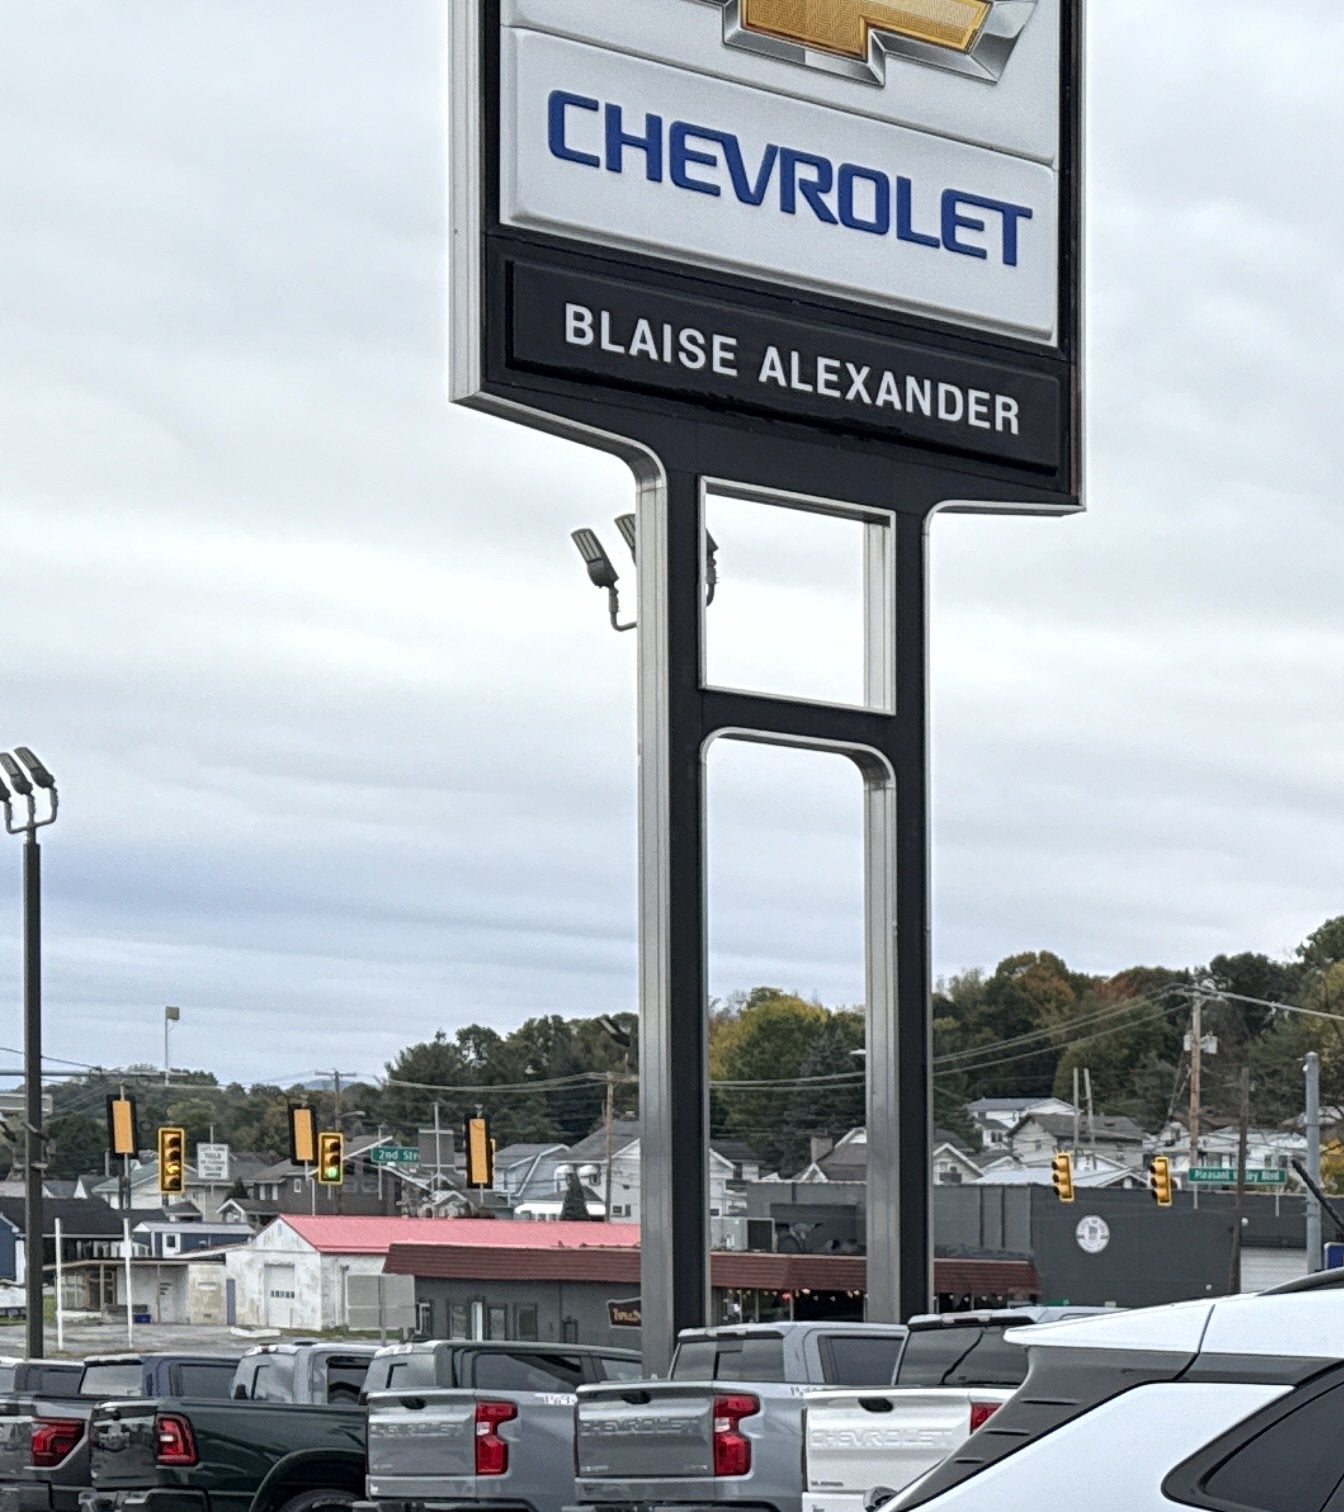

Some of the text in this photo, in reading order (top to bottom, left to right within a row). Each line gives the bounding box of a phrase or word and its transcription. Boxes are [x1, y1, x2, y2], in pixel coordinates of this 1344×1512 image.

[547, 89, 1033, 267] CHEVROLET
[563, 302, 1020, 435] BLAISE ALEXANDER
[378, 1149, 418, 1161] 2nd Str
[1194, 1169, 1230, 1180] Pleasant
[810, 1428, 953, 1448] CHEVROLET
